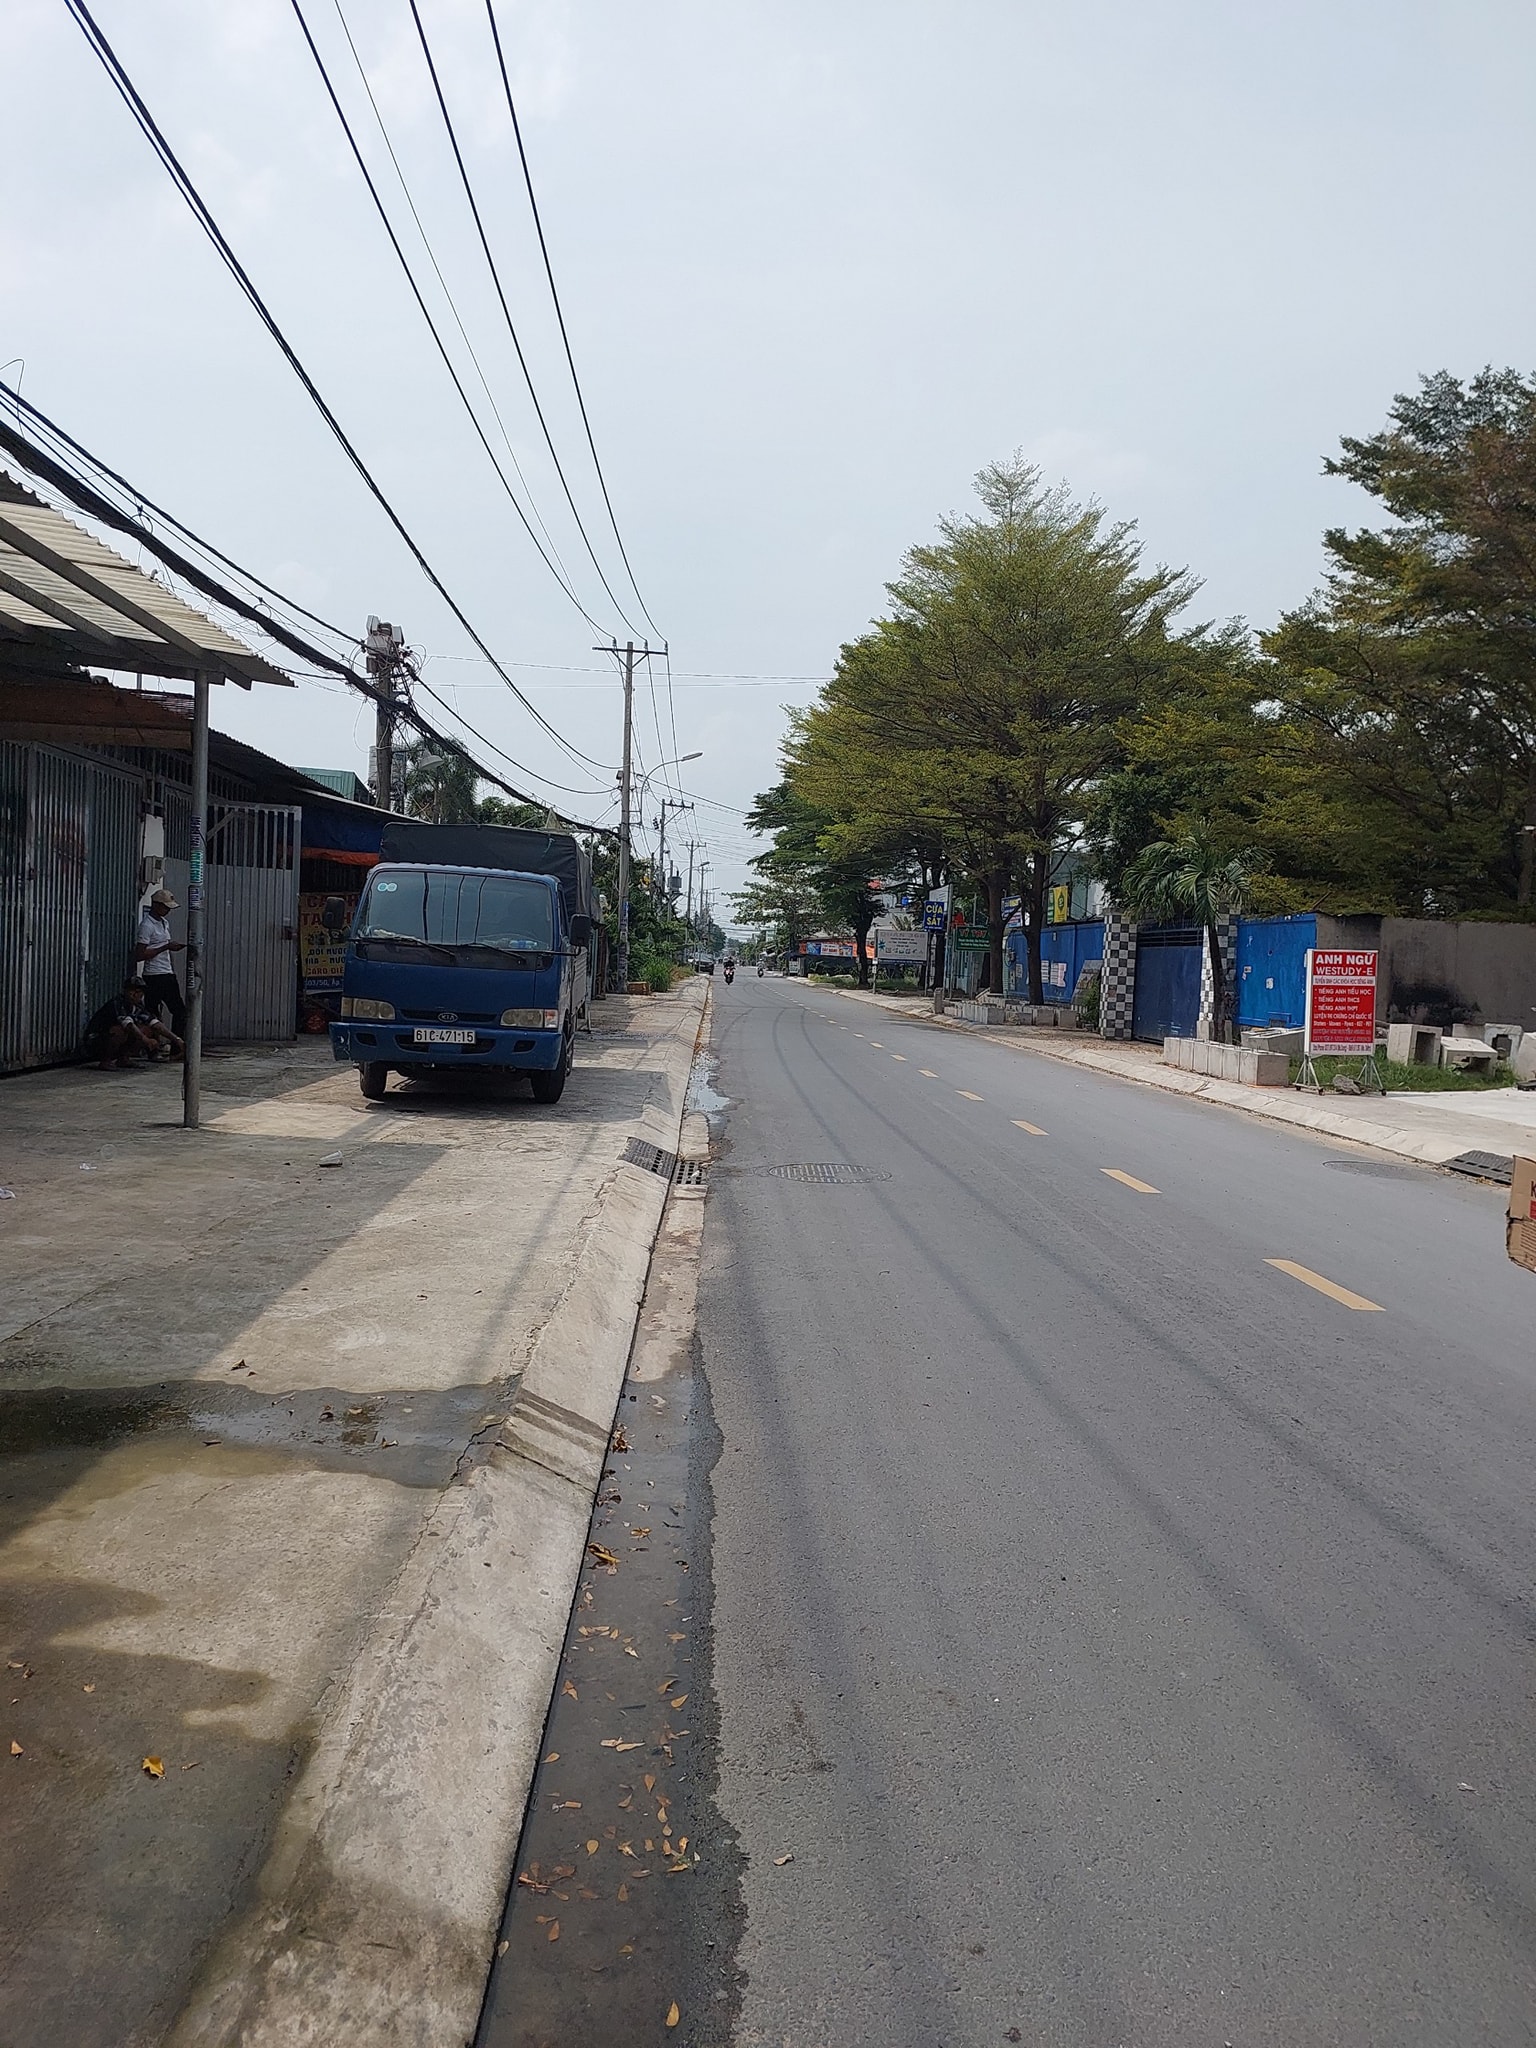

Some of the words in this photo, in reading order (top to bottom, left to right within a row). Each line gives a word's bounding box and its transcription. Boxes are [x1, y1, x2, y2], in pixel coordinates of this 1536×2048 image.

[1316, 954, 1342, 965] ANH
[1346, 952, 1375, 966] NGỮ
[1316, 966, 1373, 976] WESTUDY-E
